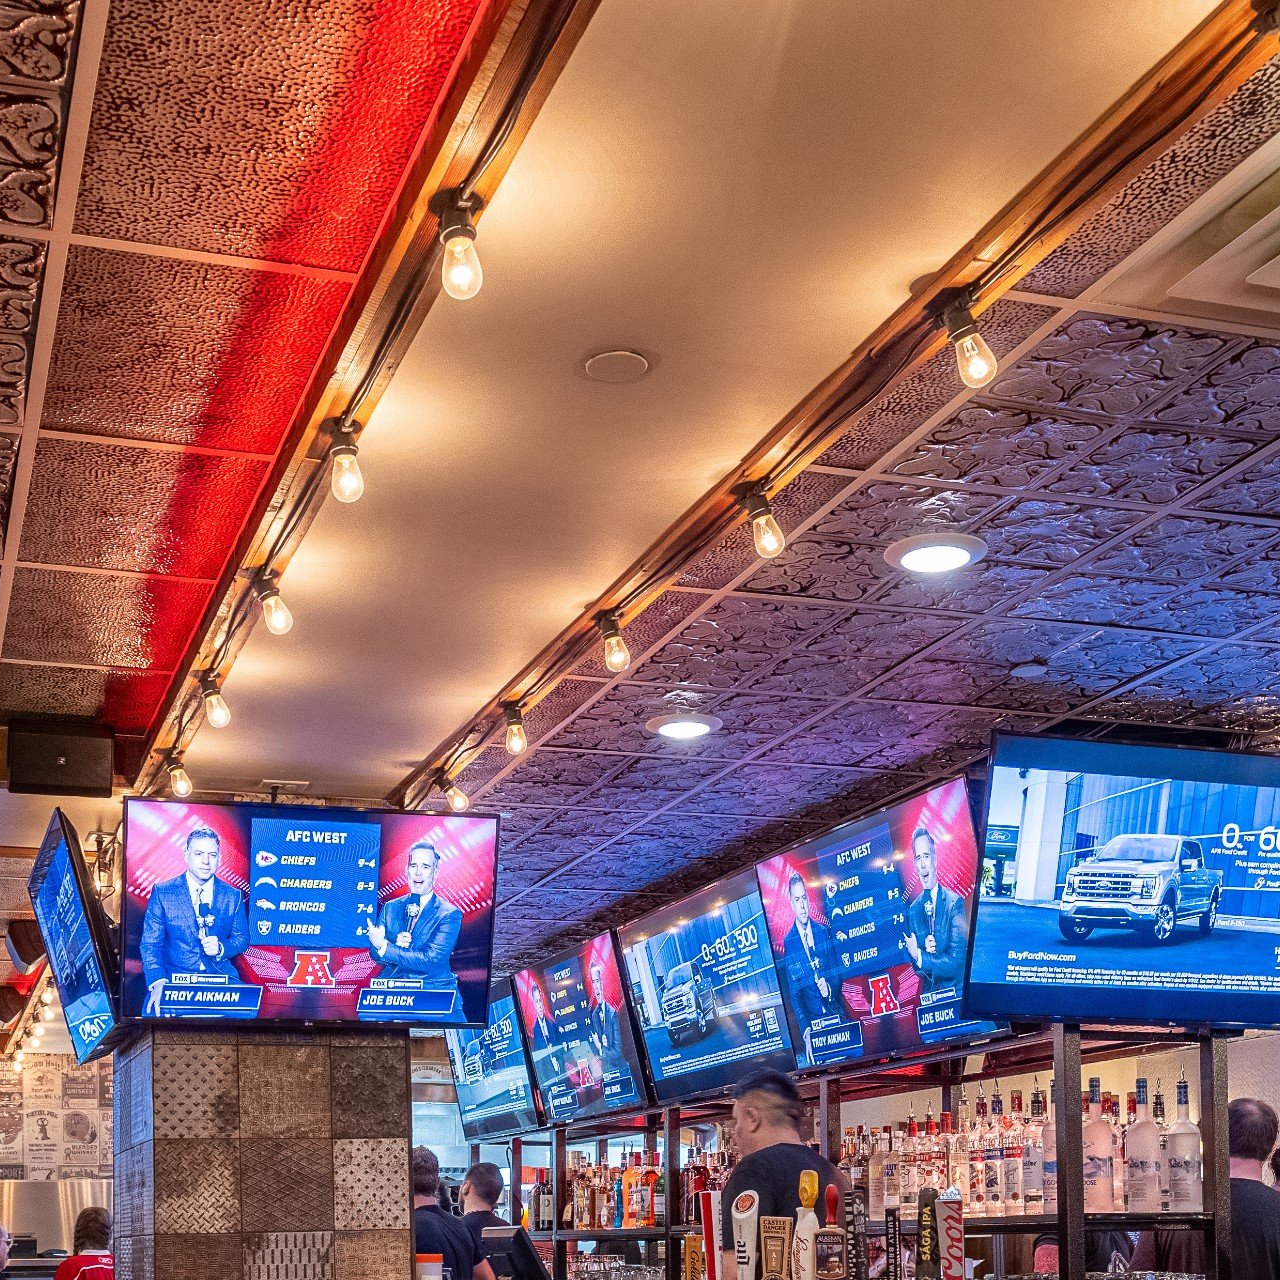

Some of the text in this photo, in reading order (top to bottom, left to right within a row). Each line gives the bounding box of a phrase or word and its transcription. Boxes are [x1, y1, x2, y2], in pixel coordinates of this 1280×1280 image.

[286, 830, 347, 844] AFC WEST
[837, 842, 871, 866] AFC WEST
[281, 856, 376, 868] CHIEFS 9-4
[280, 879, 375, 891] CHARGERS 8-5
[839, 876, 859, 891] CHIEFS
[279, 901, 373, 913] BRONCOS 7-6
[844, 897, 874, 915] CHARGERS
[278, 924, 321, 935] RAIDERS
[849, 913, 904, 938] BRONCOS 7-6
[715, 936, 730, 957] 60
[854, 947, 878, 962] RAIDERS
[1008, 951, 1076, 962] BuyFordNow.com
[372, 980, 386, 988] FOX
[164, 990, 240, 1002] TROY AIKMAN
[362, 995, 415, 1007] JOE BUCK
[921, 1008, 955, 1026] JOE BUCK
[923, 1206, 931, 1225] IPA
[816, 1235, 842, 1243] ALASKAN
[737, 1241, 751, 1266] Lite
